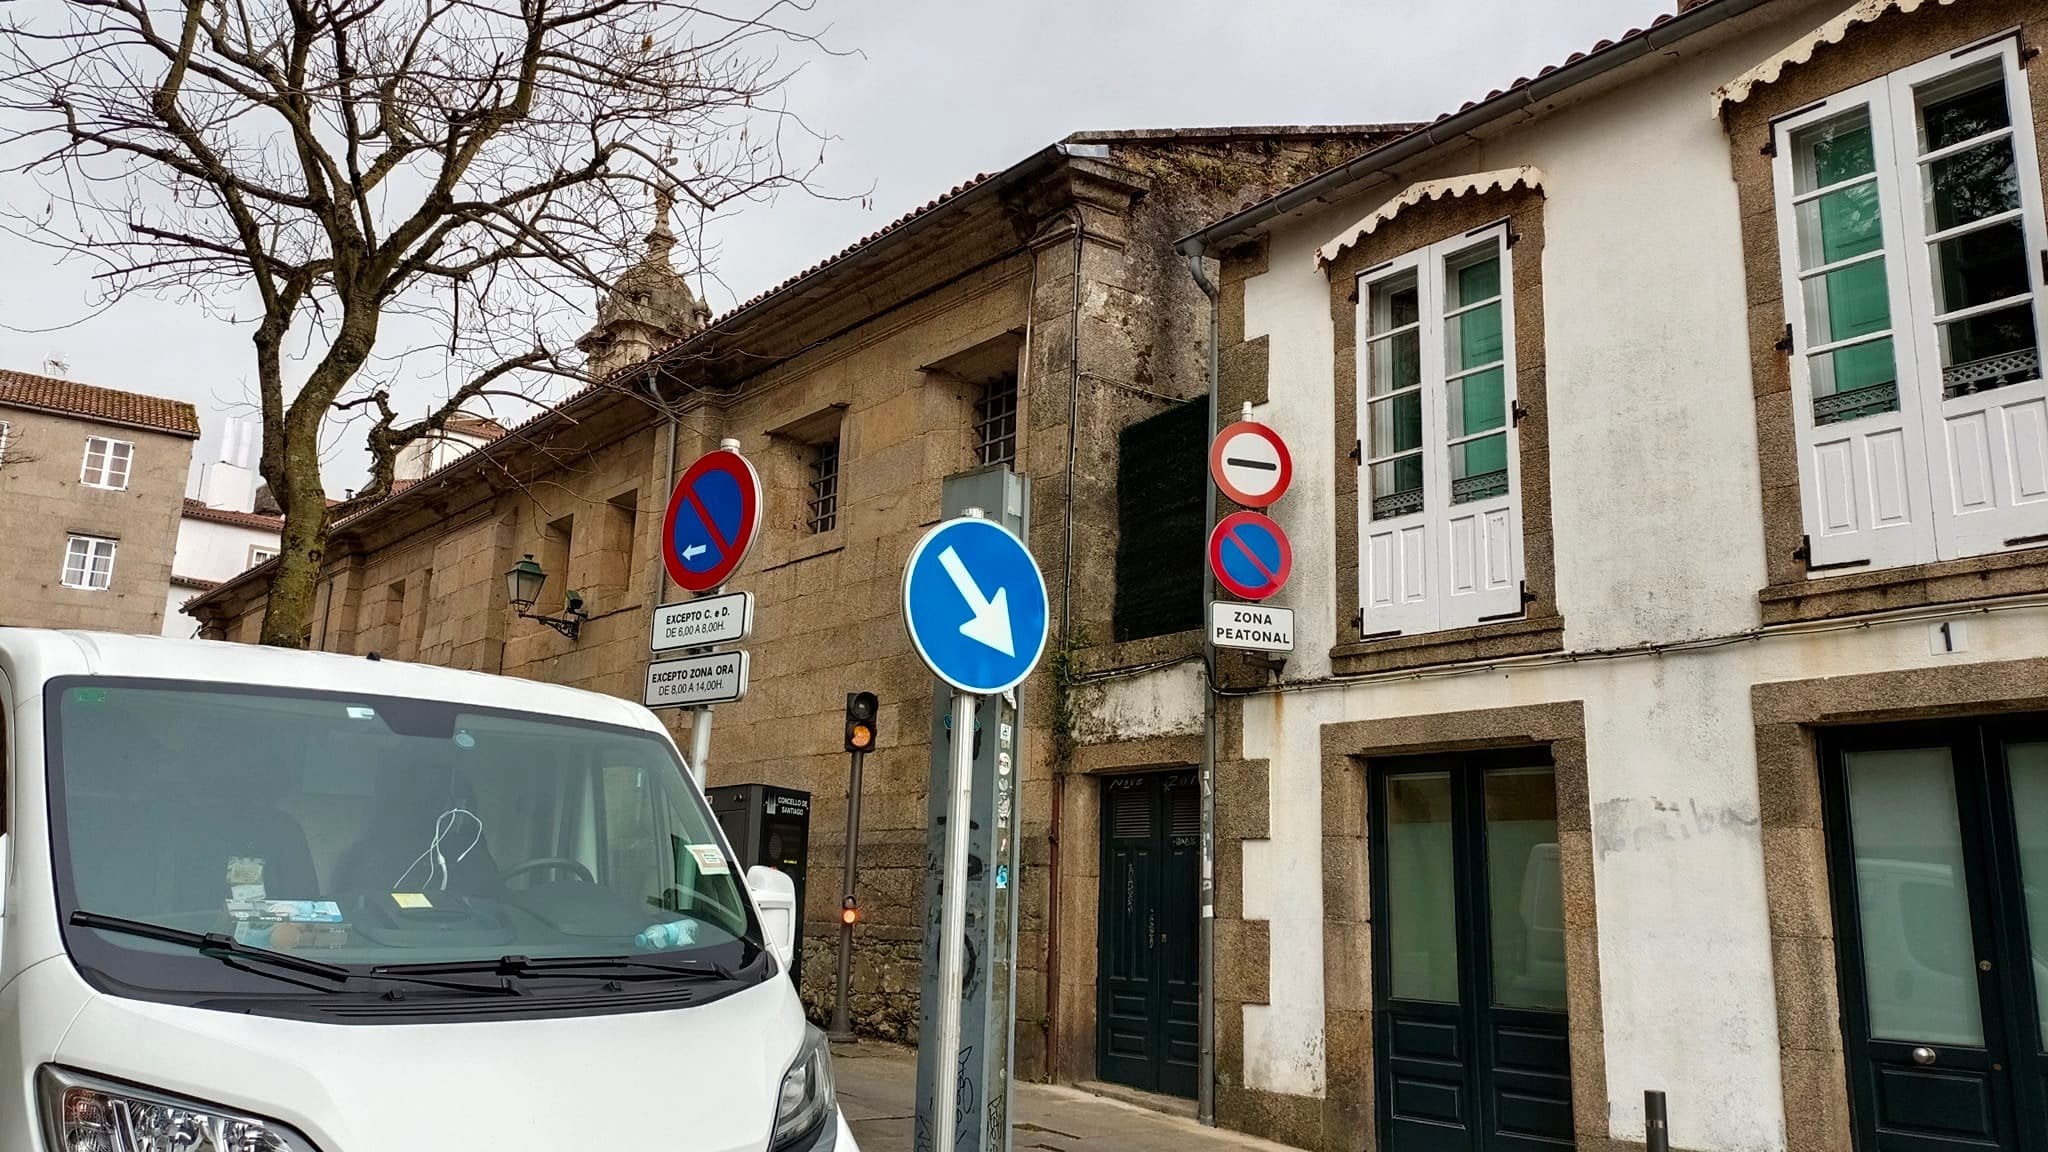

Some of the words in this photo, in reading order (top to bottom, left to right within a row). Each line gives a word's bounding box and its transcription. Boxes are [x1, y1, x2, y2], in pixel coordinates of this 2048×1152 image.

[666, 611, 701, 625] EXCEPTO
[704, 609, 712, 619] C.
[714, 610, 720, 618] e
[721, 607, 730, 617] D.
[1234, 611, 1272, 625] ZONA
[665, 628, 676, 638] DE
[678, 625, 694, 638] 6,00
[694, 624, 701, 634] A
[1216, 627, 1290, 644] PEATONAL
[1940, 622, 1953, 652] 1
[652, 670, 688, 683] EXCEPTO
[690, 667, 713, 679] ZONA
[715, 664, 734, 676] ORA
[658, 686, 670, 696] DE
[671, 683, 687, 696] 8,00
[688, 682, 694, 693] A
[777, 796, 801, 806] CONCELLO
[781, 806, 804, 816] SANTIAGO
